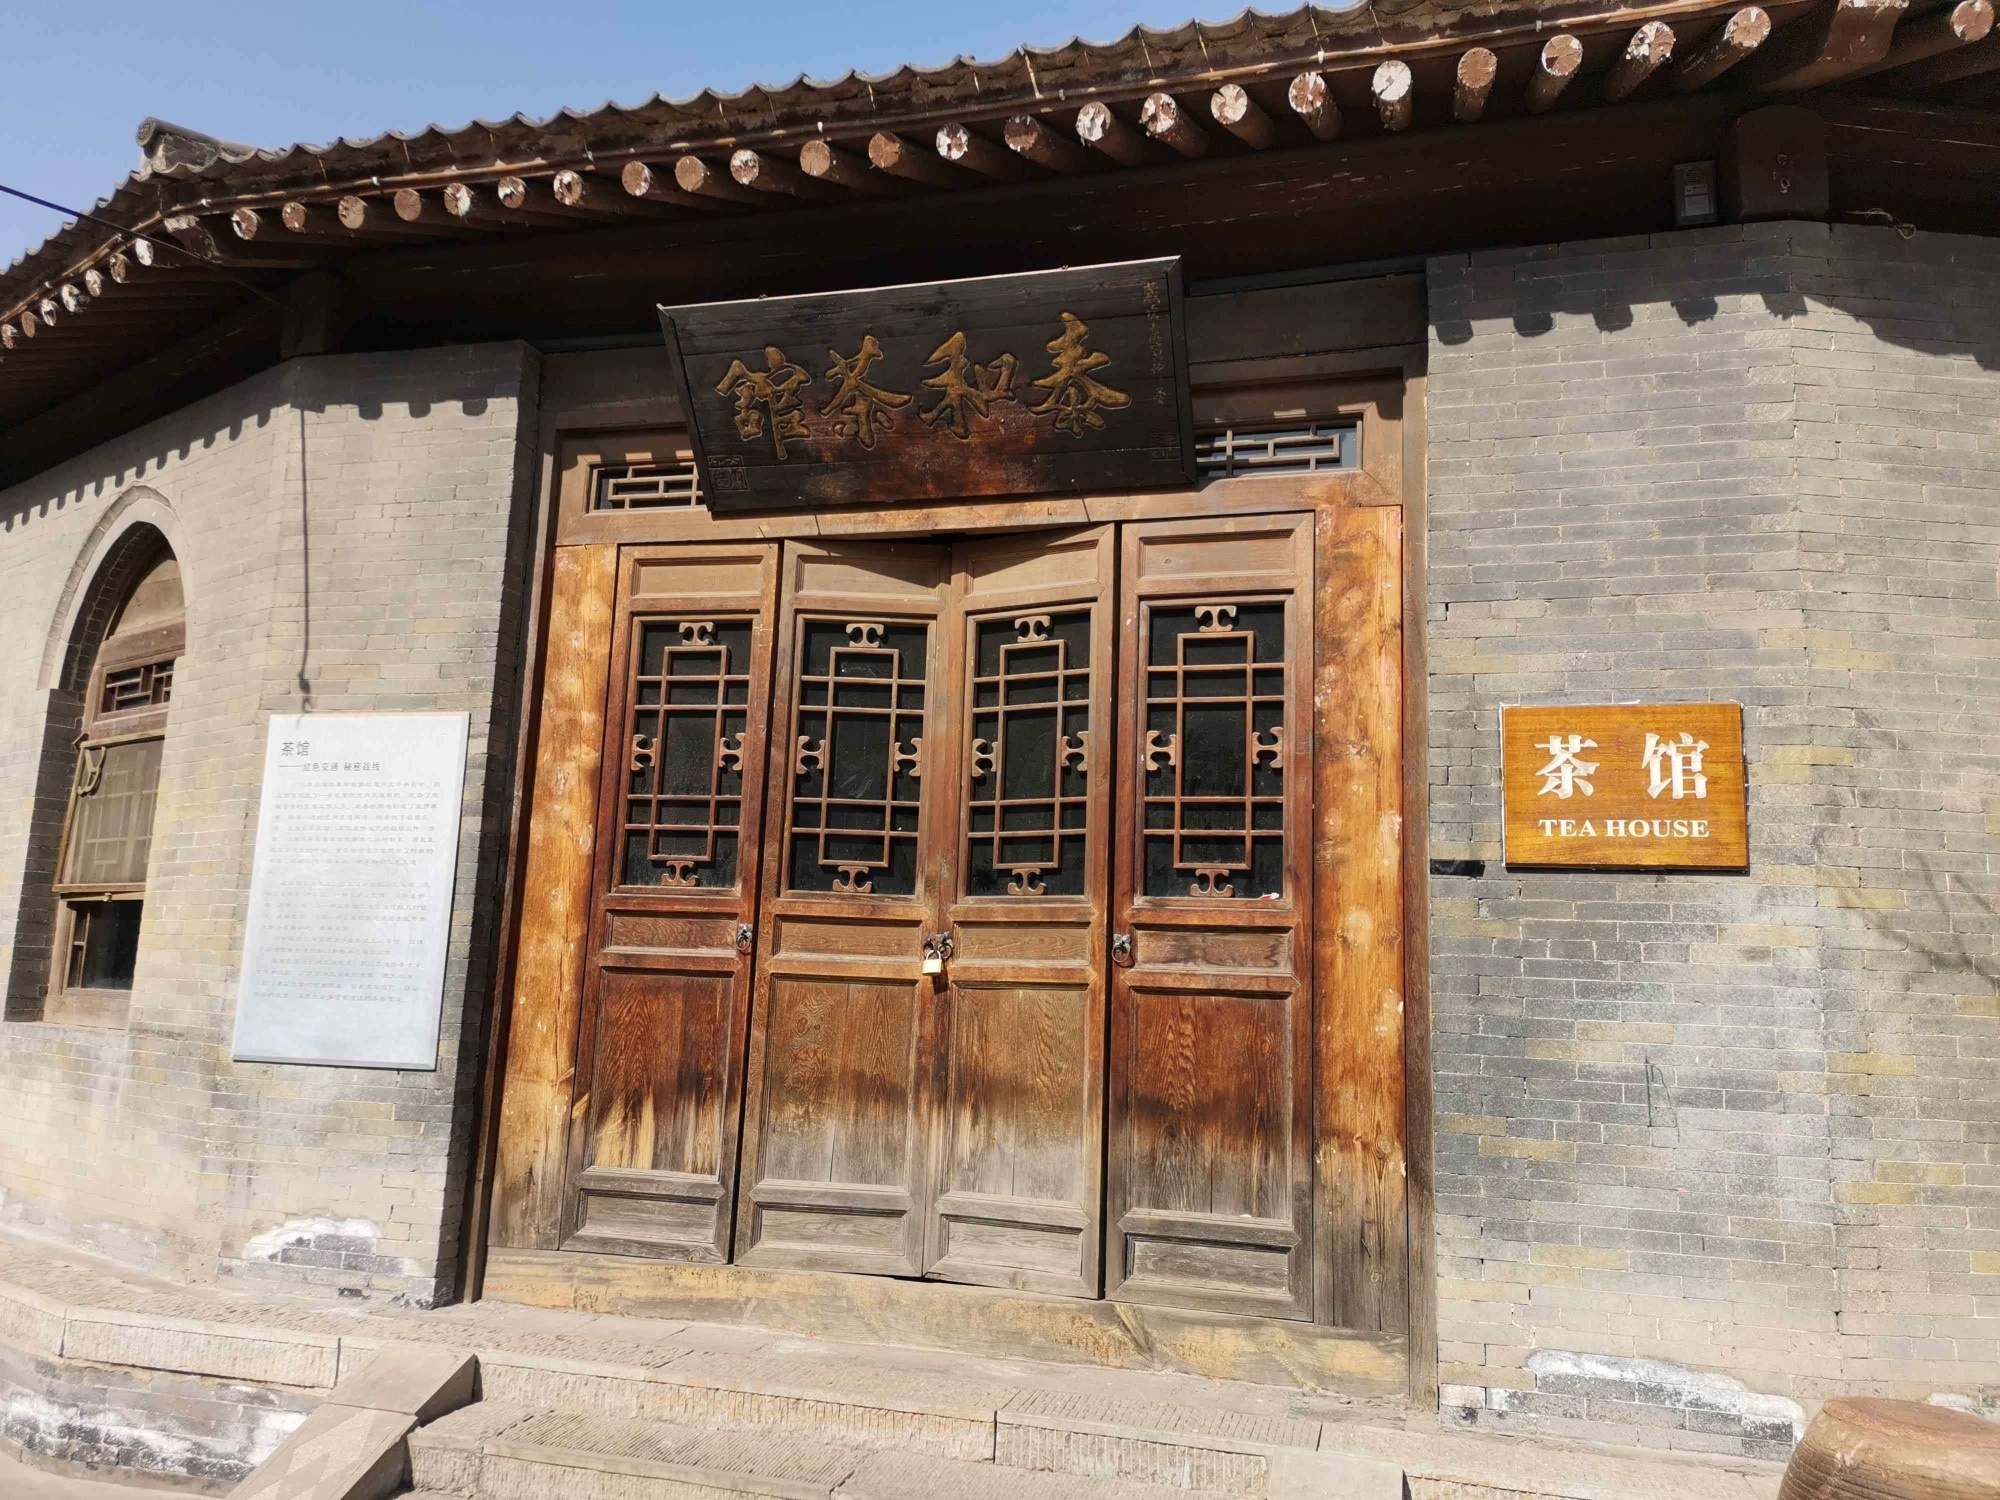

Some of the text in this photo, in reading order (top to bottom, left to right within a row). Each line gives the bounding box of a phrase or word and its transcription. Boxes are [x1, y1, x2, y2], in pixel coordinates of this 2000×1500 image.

[281, 741, 310, 757] 茶馆
[1534, 732, 1710, 799] 茶馆
[1538, 819, 1710, 838] TEA HOUSE
